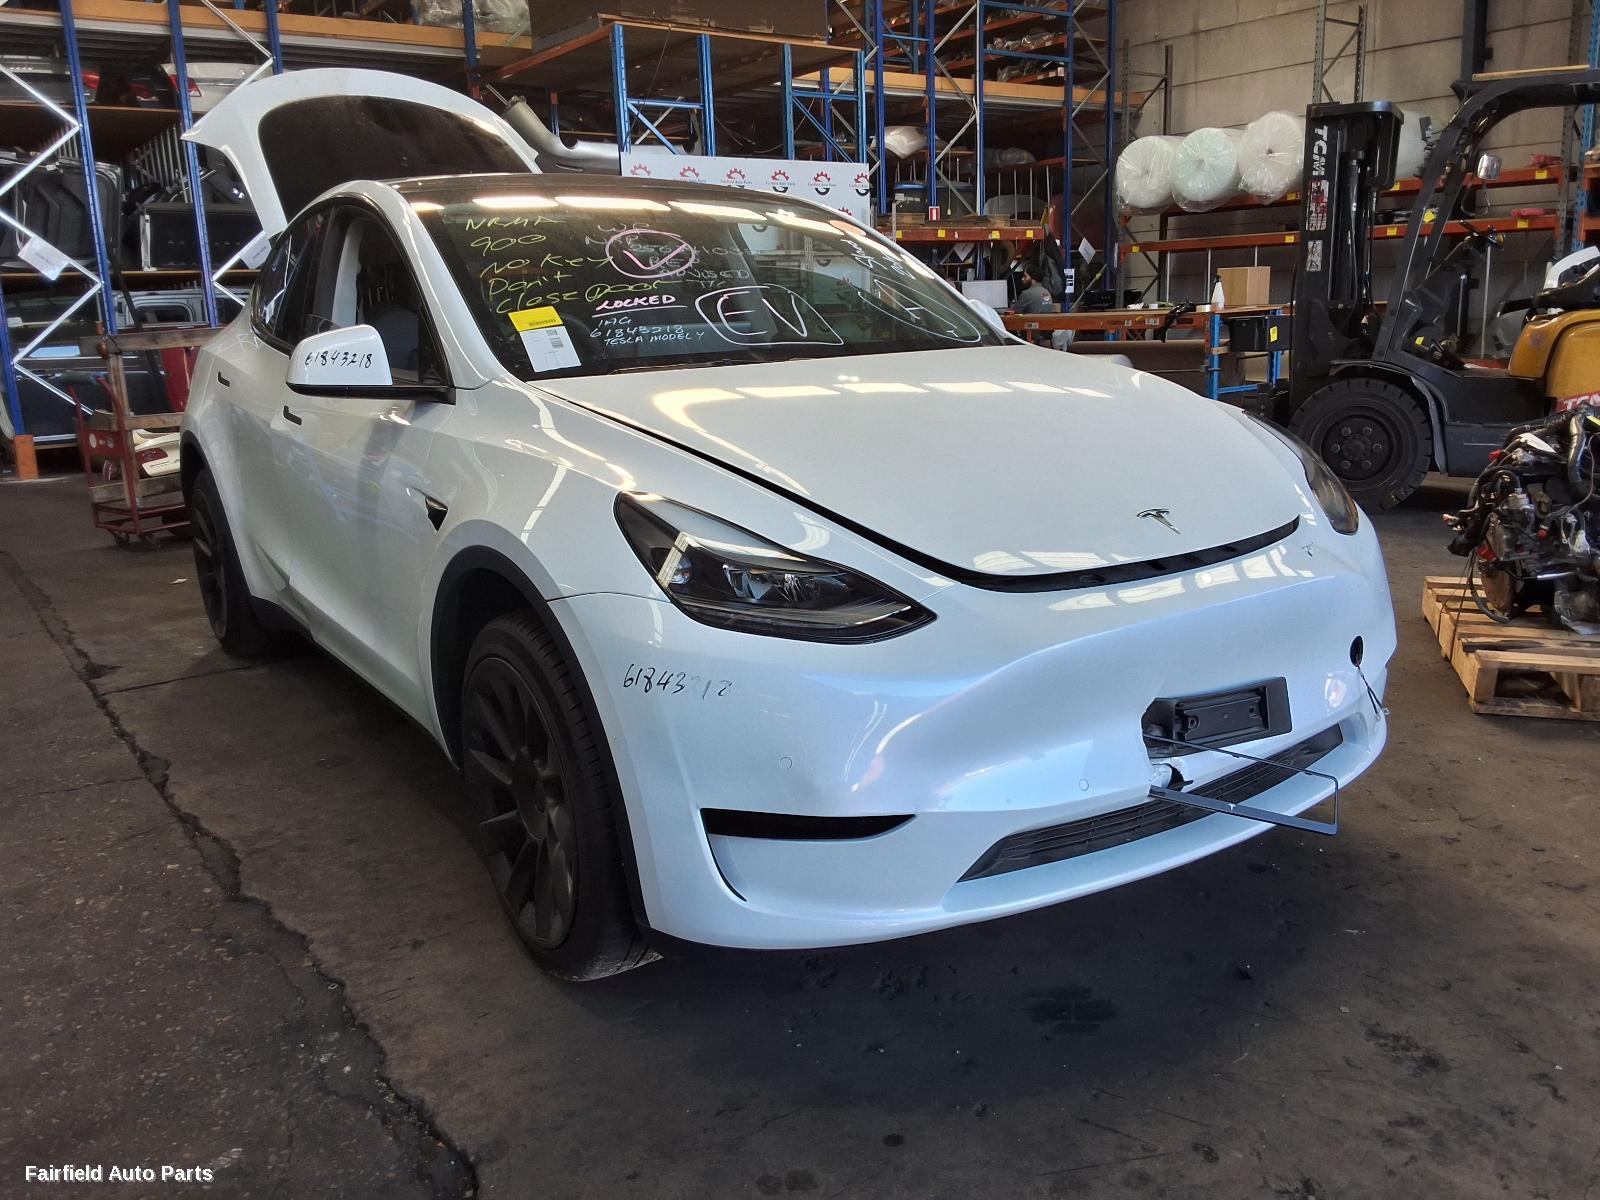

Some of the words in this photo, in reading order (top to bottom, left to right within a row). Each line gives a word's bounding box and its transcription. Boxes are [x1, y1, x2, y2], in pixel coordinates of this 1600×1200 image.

[1312, 124, 1329, 176] TCM
[470, 234, 547, 256] 900
[595, 294, 676, 311] LOCKED
[716, 290, 808, 337] EV
[603, 335, 643, 346] TESLA
[649, 332, 692, 343] MODEL
[696, 331, 705, 341] Y
[304, 349, 373, 369] 61843218
